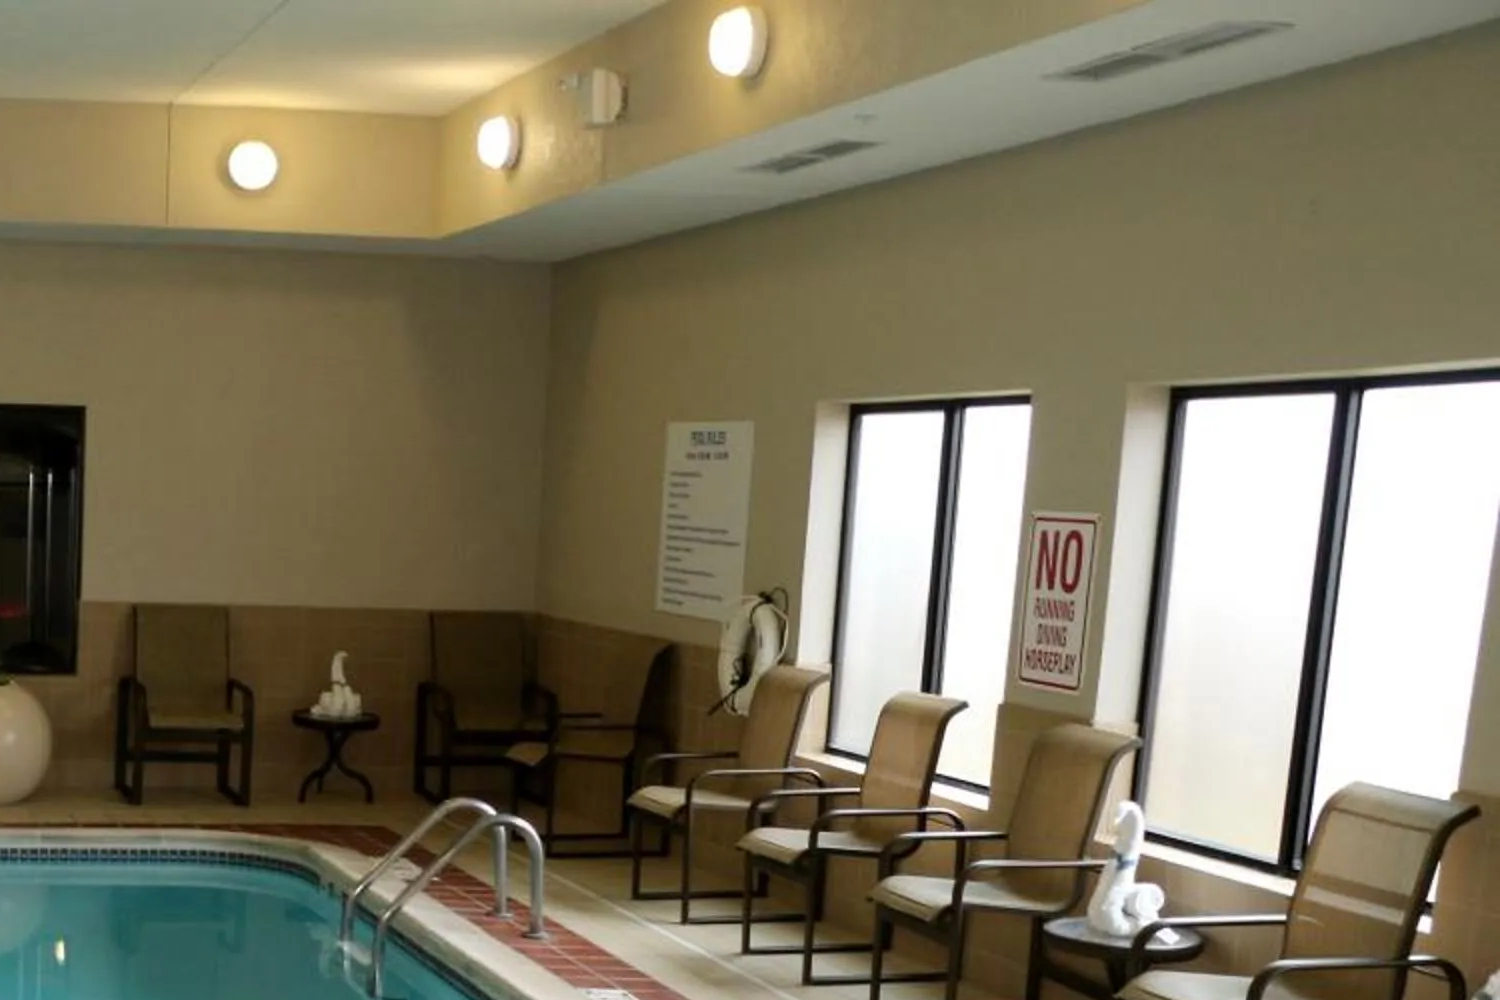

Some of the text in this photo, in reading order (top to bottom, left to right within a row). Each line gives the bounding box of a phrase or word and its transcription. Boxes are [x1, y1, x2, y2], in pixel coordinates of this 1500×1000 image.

[1035, 530, 1083, 593] NO
[1033, 597, 1076, 622] RUNNING
[1036, 623, 1068, 648] DIVING
[1024, 648, 1078, 675] HORSEPLAY
